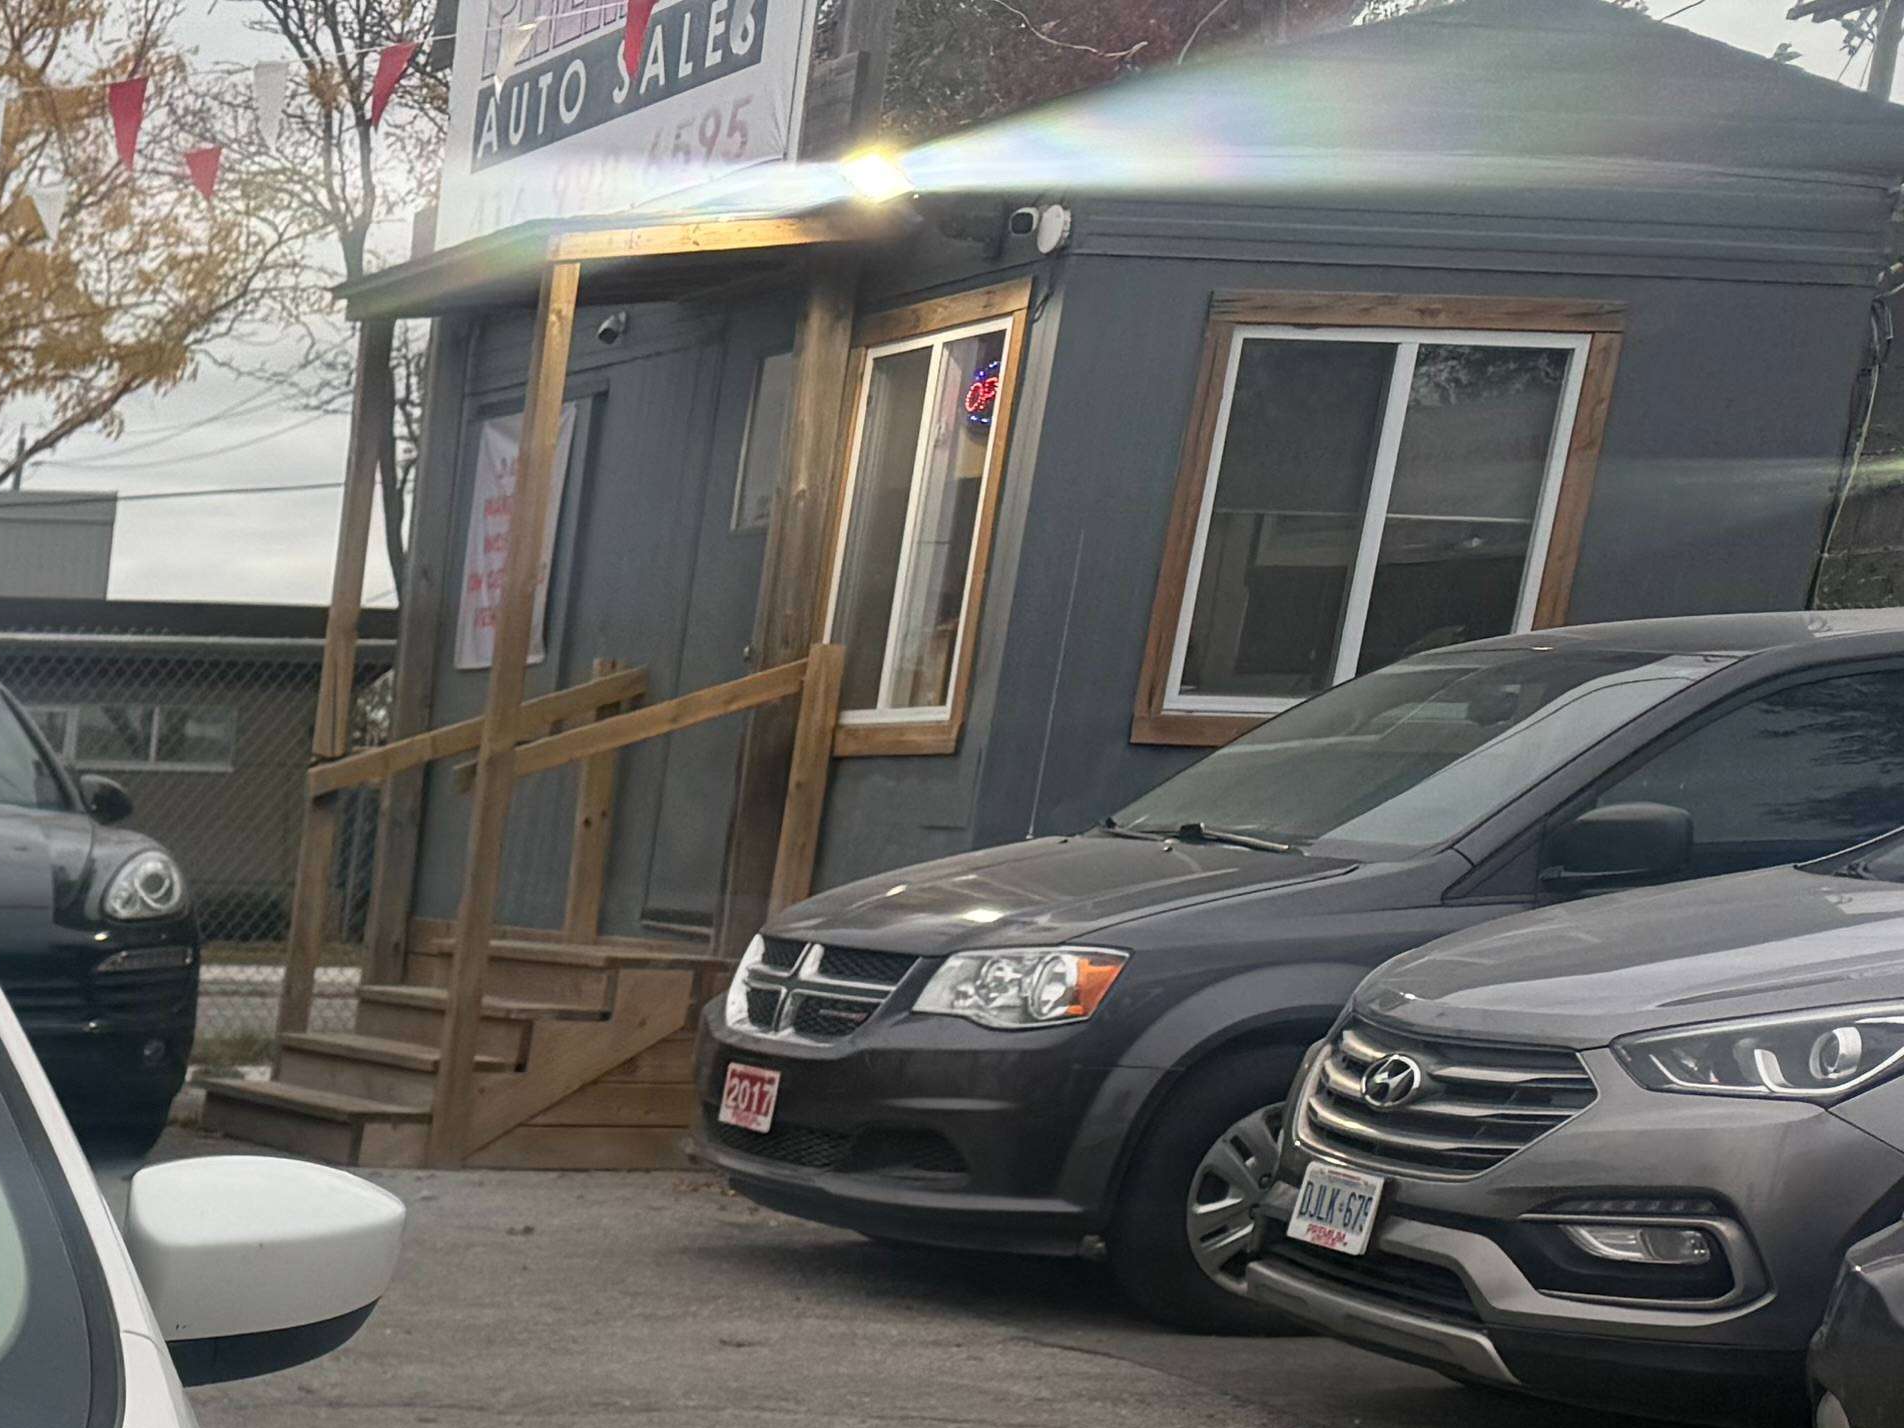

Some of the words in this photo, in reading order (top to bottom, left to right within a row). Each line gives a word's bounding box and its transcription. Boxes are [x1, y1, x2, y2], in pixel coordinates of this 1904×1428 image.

[476, 58, 588, 160] AUTO
[726, 1076, 774, 1115] 2017
[1298, 1180, 1341, 1225] DJLK
